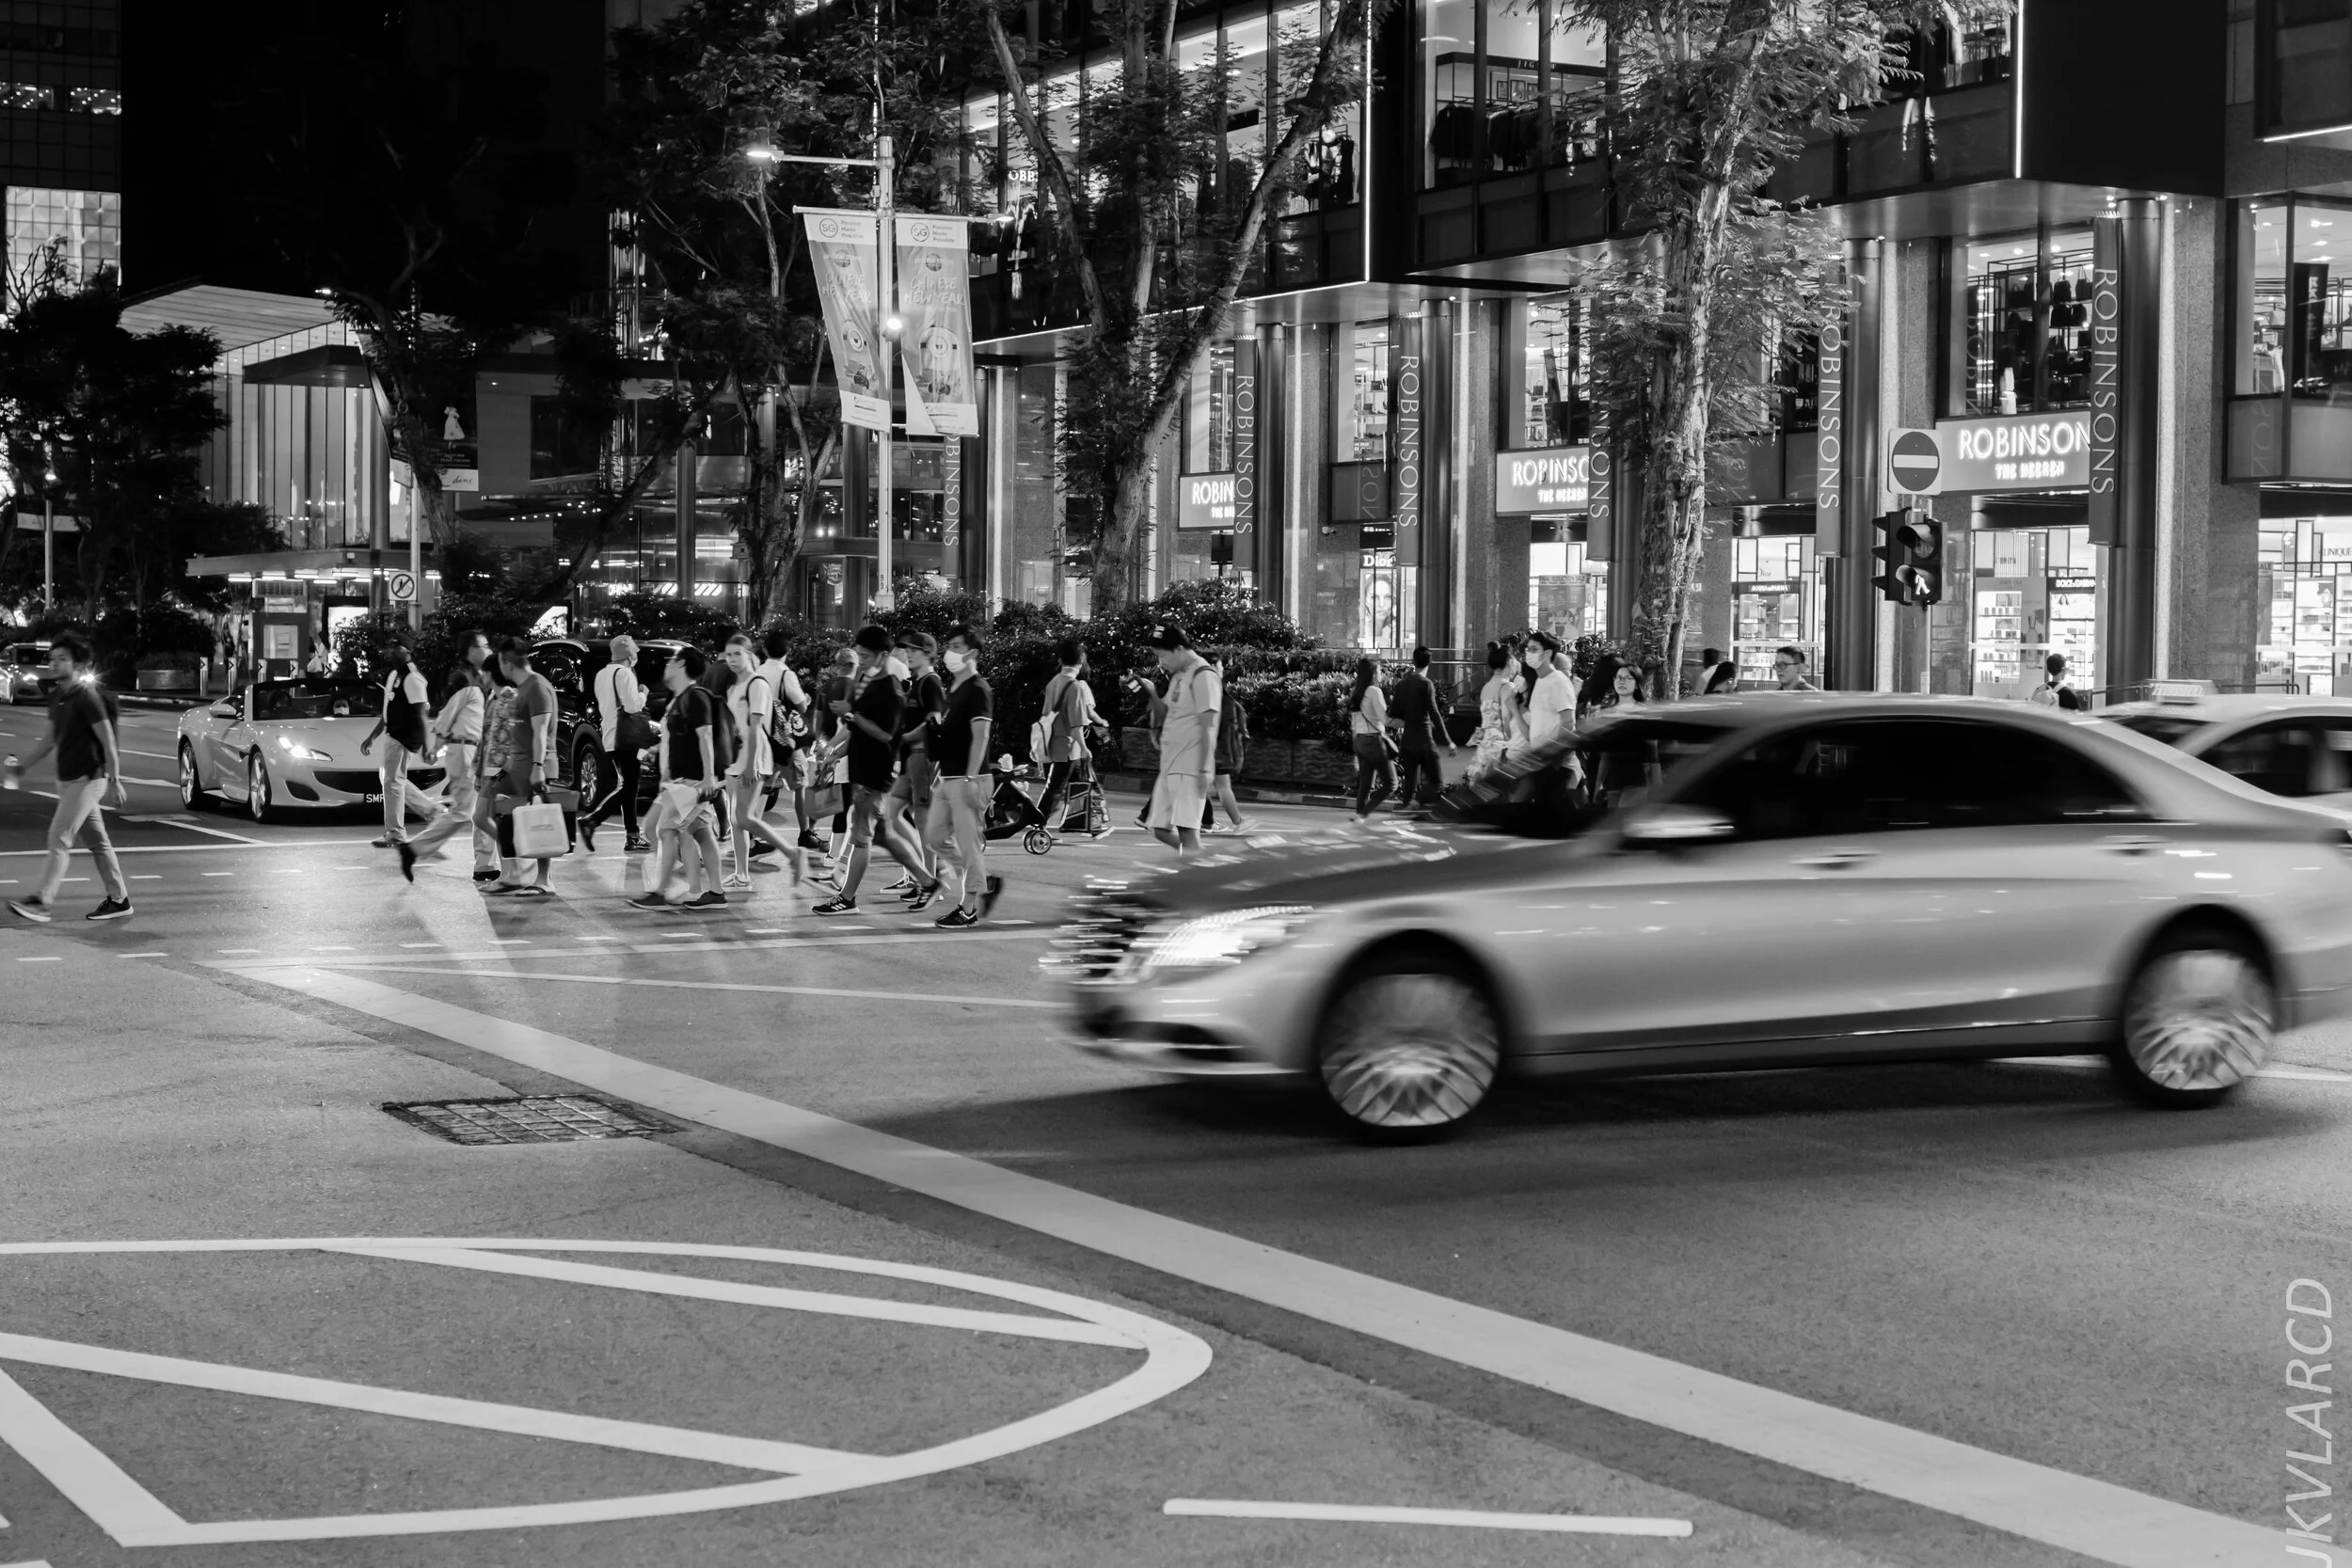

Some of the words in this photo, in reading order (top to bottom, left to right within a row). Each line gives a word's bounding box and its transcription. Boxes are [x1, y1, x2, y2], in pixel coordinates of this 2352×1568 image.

[2091, 269, 2118, 495] ROBINSONS
[1235, 375, 1255, 534] ROBINSONS
[1399, 356, 1420, 528] ROBINSONS
[1958, 421, 2091, 460] ROBINSON
[1512, 454, 1590, 487] ROBINSO
[1192, 480, 1235, 505] ROBIN
[1362, 554, 1395, 567] Dior
